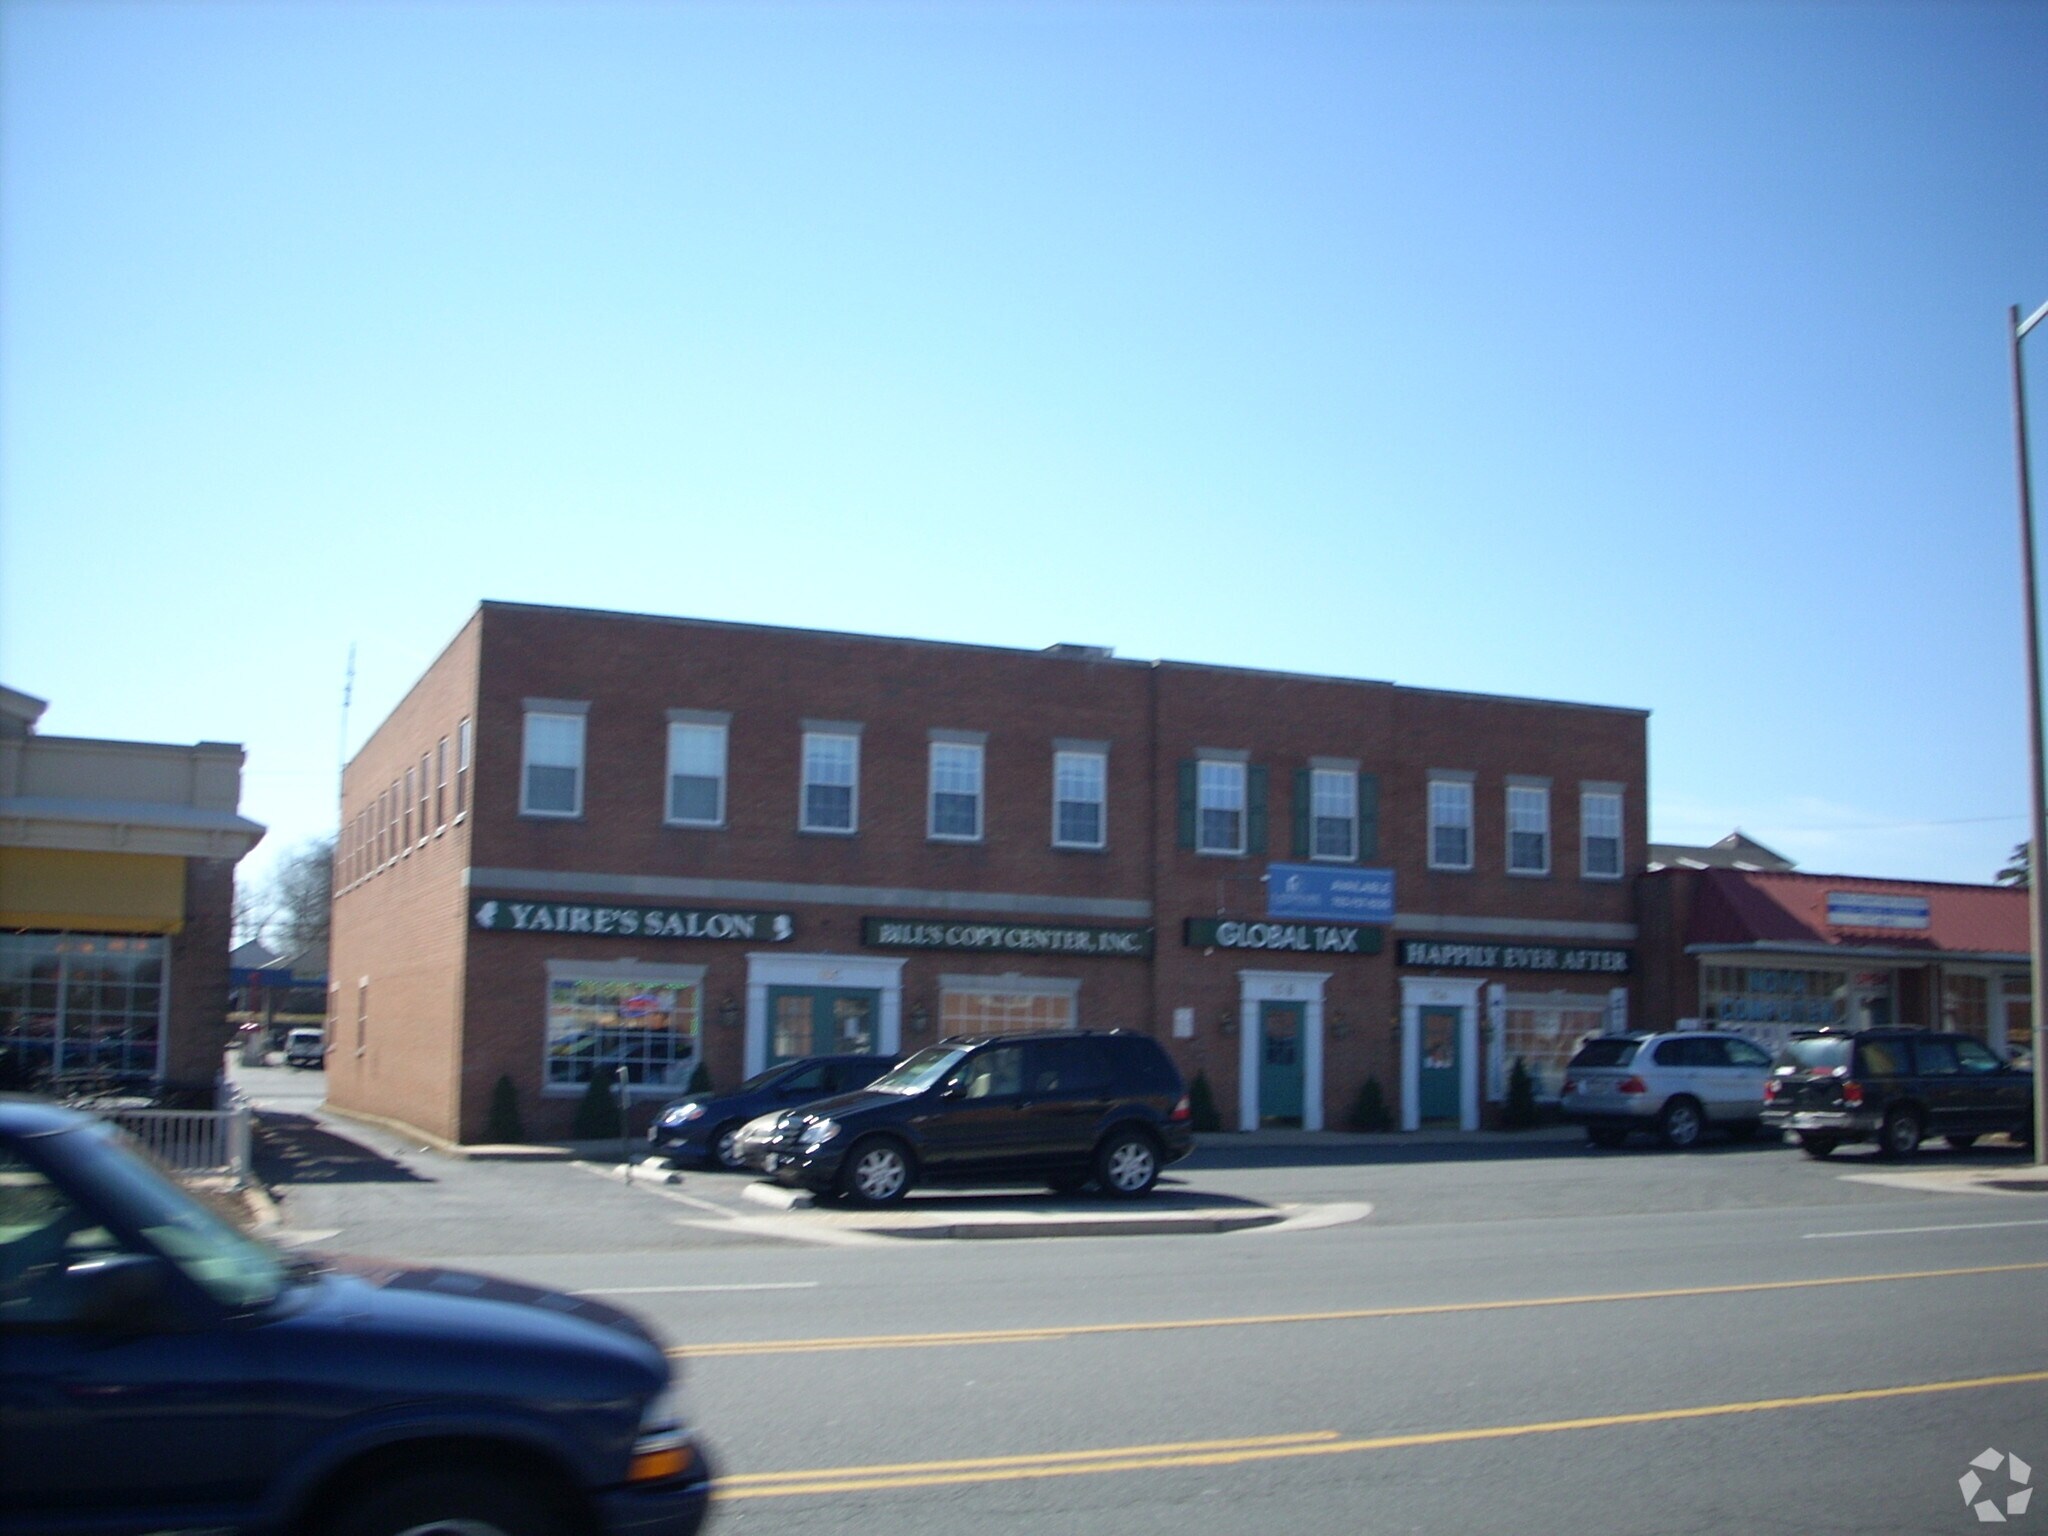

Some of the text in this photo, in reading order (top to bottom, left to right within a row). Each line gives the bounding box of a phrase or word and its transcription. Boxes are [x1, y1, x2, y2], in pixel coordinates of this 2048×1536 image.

[508, 903, 756, 939] YAIRE'S SALON
[945, 926, 1005, 947] COPY
[1215, 921, 1359, 952] GLOBAL TAX
[1405, 942, 1629, 972] HAPPILY EVER AFTER
